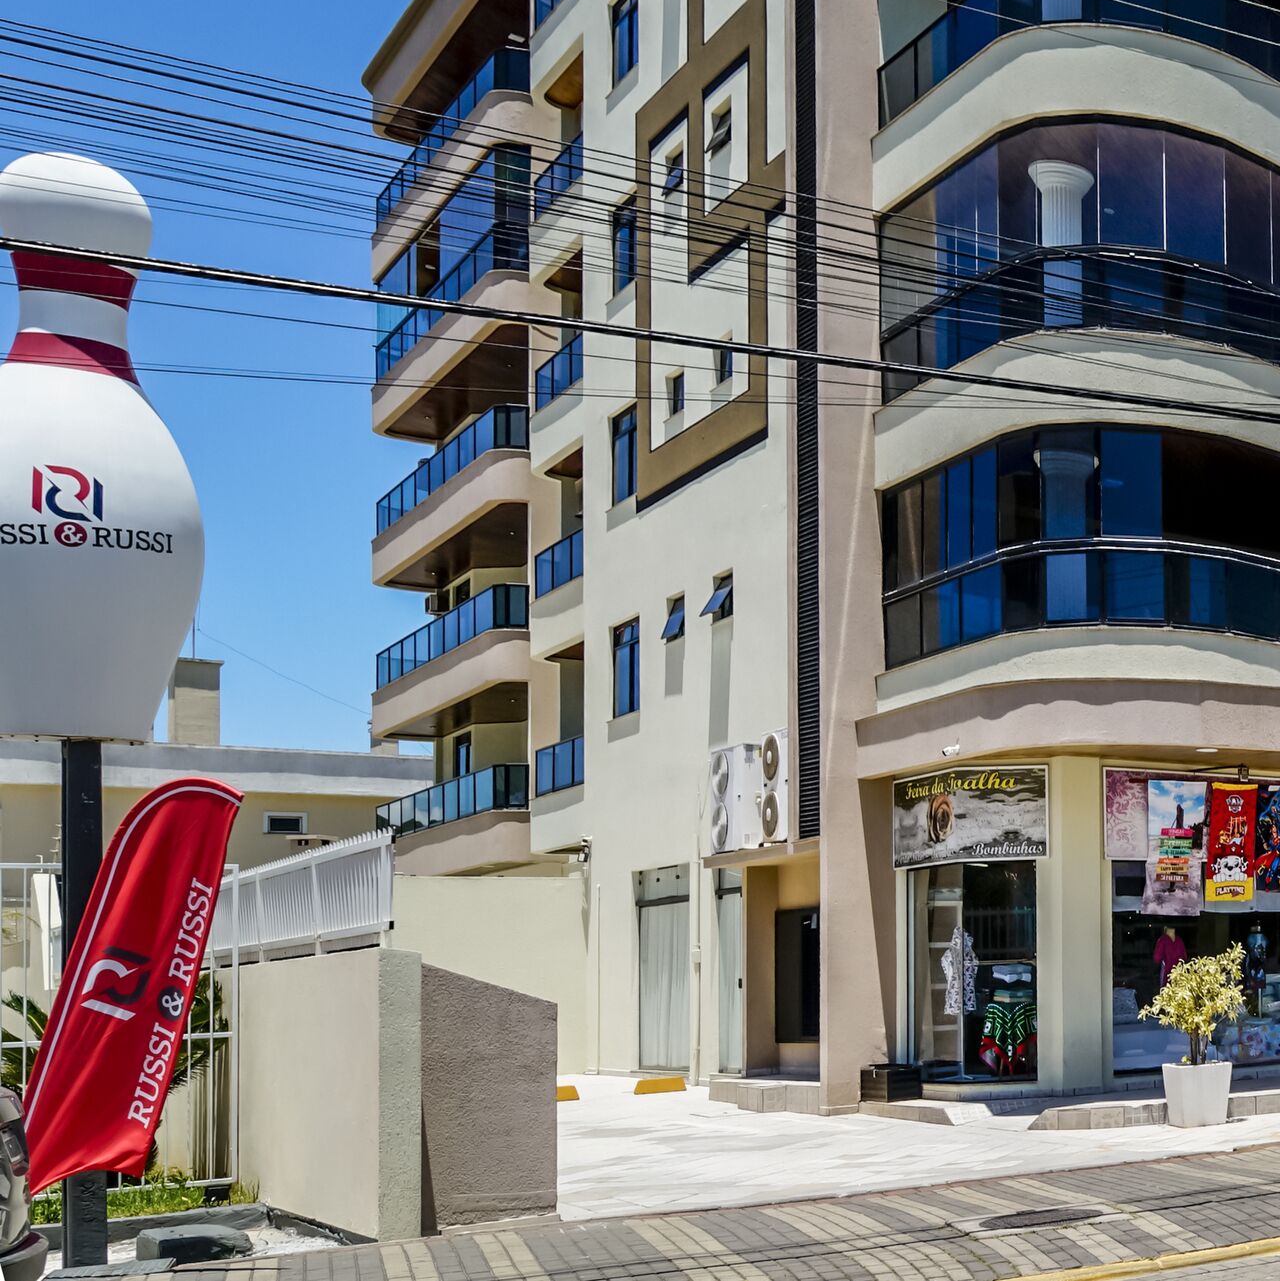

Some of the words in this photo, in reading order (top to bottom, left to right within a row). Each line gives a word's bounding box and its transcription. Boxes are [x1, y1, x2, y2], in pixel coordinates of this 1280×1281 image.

[60, 524, 84, 544] &
[92, 526, 173, 554] RUSSI
[905, 782, 929, 800] Feira
[931, 777, 944, 795] da
[946, 771, 1017, 795] Toalha
[971, 841, 1043, 857] Bombinhas
[168, 877, 213, 987] RUSSI
[161, 989, 185, 1017] &
[127, 1021, 176, 1129] RUSSI
